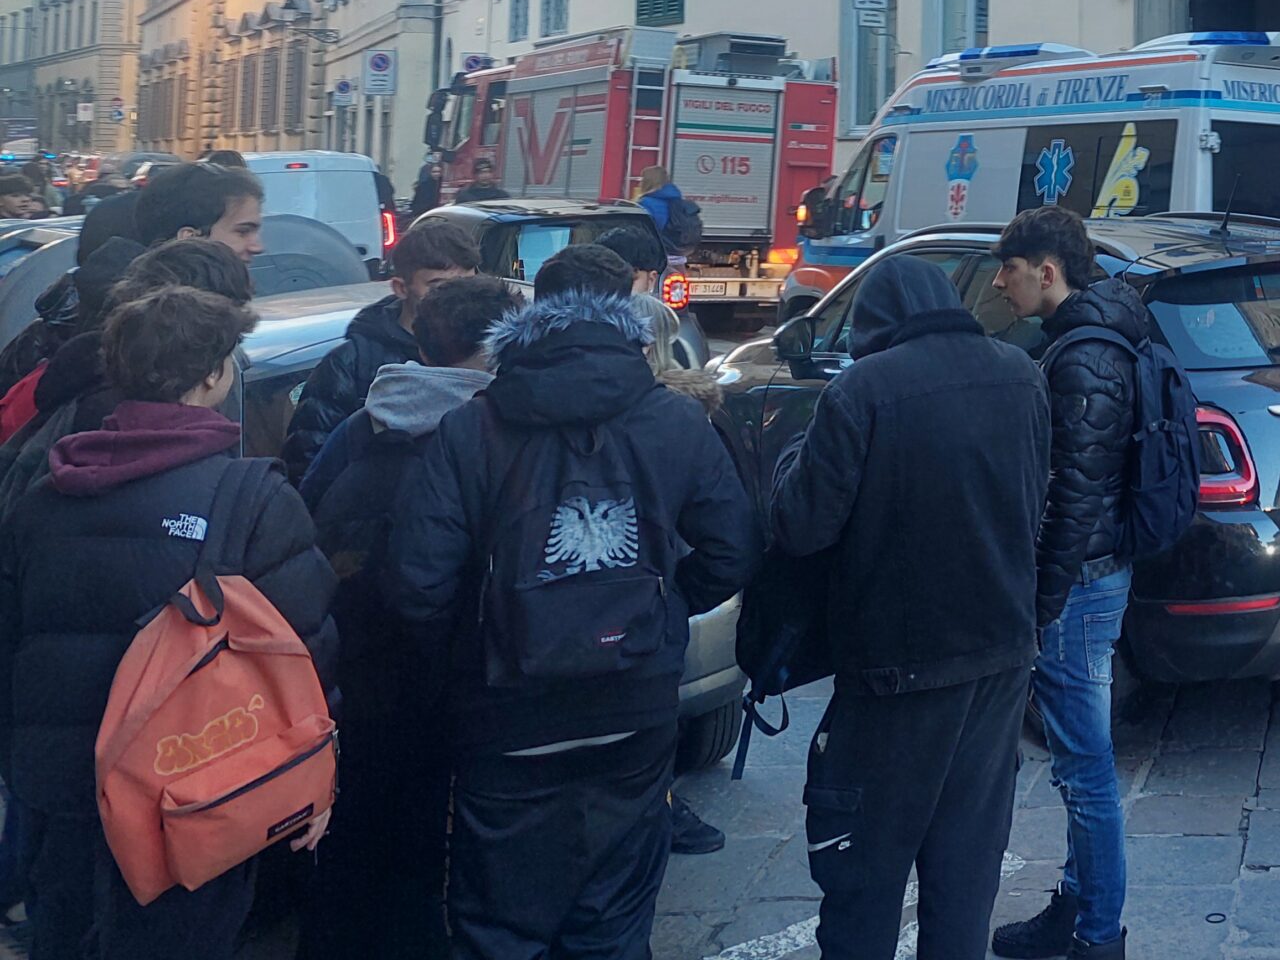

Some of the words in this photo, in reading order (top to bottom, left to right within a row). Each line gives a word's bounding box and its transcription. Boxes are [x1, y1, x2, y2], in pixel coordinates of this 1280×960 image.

[923, 82, 1032, 113] MISERICORDIA
[1036, 86, 1048, 107] di
[1053, 75, 1129, 106] FIRENZE
[683, 98, 713, 110] VIGILI
[715, 100, 734, 112] DEL
[737, 102, 772, 114] FUOCO
[720, 156, 751, 175] 115
[161, 518, 197, 533] NORTH
[179, 513, 198, 525] THE
[168, 527, 194, 539] FACE
